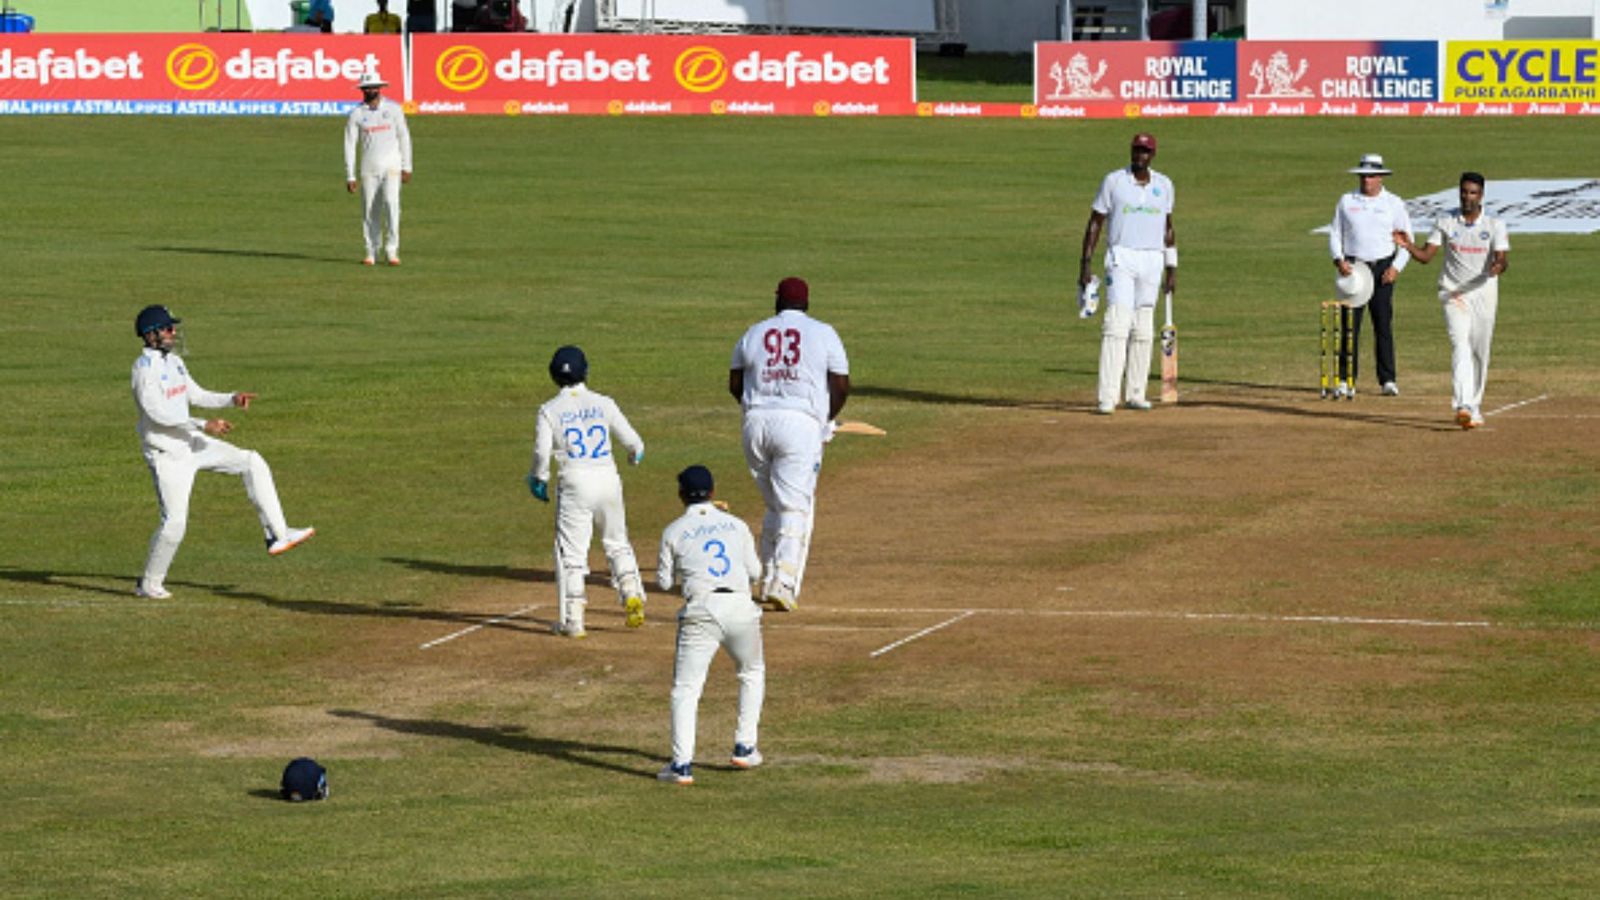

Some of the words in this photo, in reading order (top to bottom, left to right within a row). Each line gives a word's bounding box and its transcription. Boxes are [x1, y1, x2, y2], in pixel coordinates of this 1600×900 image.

[225, 49, 381, 85] dafabet
[494, 50, 651, 87] dafabet
[732, 51, 890, 88] dafabet
[1145, 56, 1206, 78] ROYAL
[1346, 56, 1407, 79] ROYAL
[1456, 48, 1598, 83] CYCLE
[1120, 80, 1231, 99] CHALLENGE
[1321, 79, 1433, 98] CHALLENGE
[1455, 86, 1495, 98] PURE
[32, 102, 69, 114] PIPES
[72, 101, 133, 114] ASTRAL
[134, 102, 173, 114] PIPES
[177, 101, 236, 114] ASTRAL
[238, 103, 278, 114] PIPES
[280, 102, 341, 114] ASTRAL
[419, 102, 466, 113] dafabet
[521, 102, 569, 114] dafabet
[624, 102, 672, 114] dafabet
[727, 102, 775, 114] dafabet
[831, 103, 879, 115] dafabet
[934, 104, 982, 115] dafabet
[1038, 105, 1085, 117] dafabet
[1141, 104, 1189, 116] dafabet
[763, 328, 801, 367] 93
[564, 425, 610, 458] 32
[703, 539, 732, 577] 3
